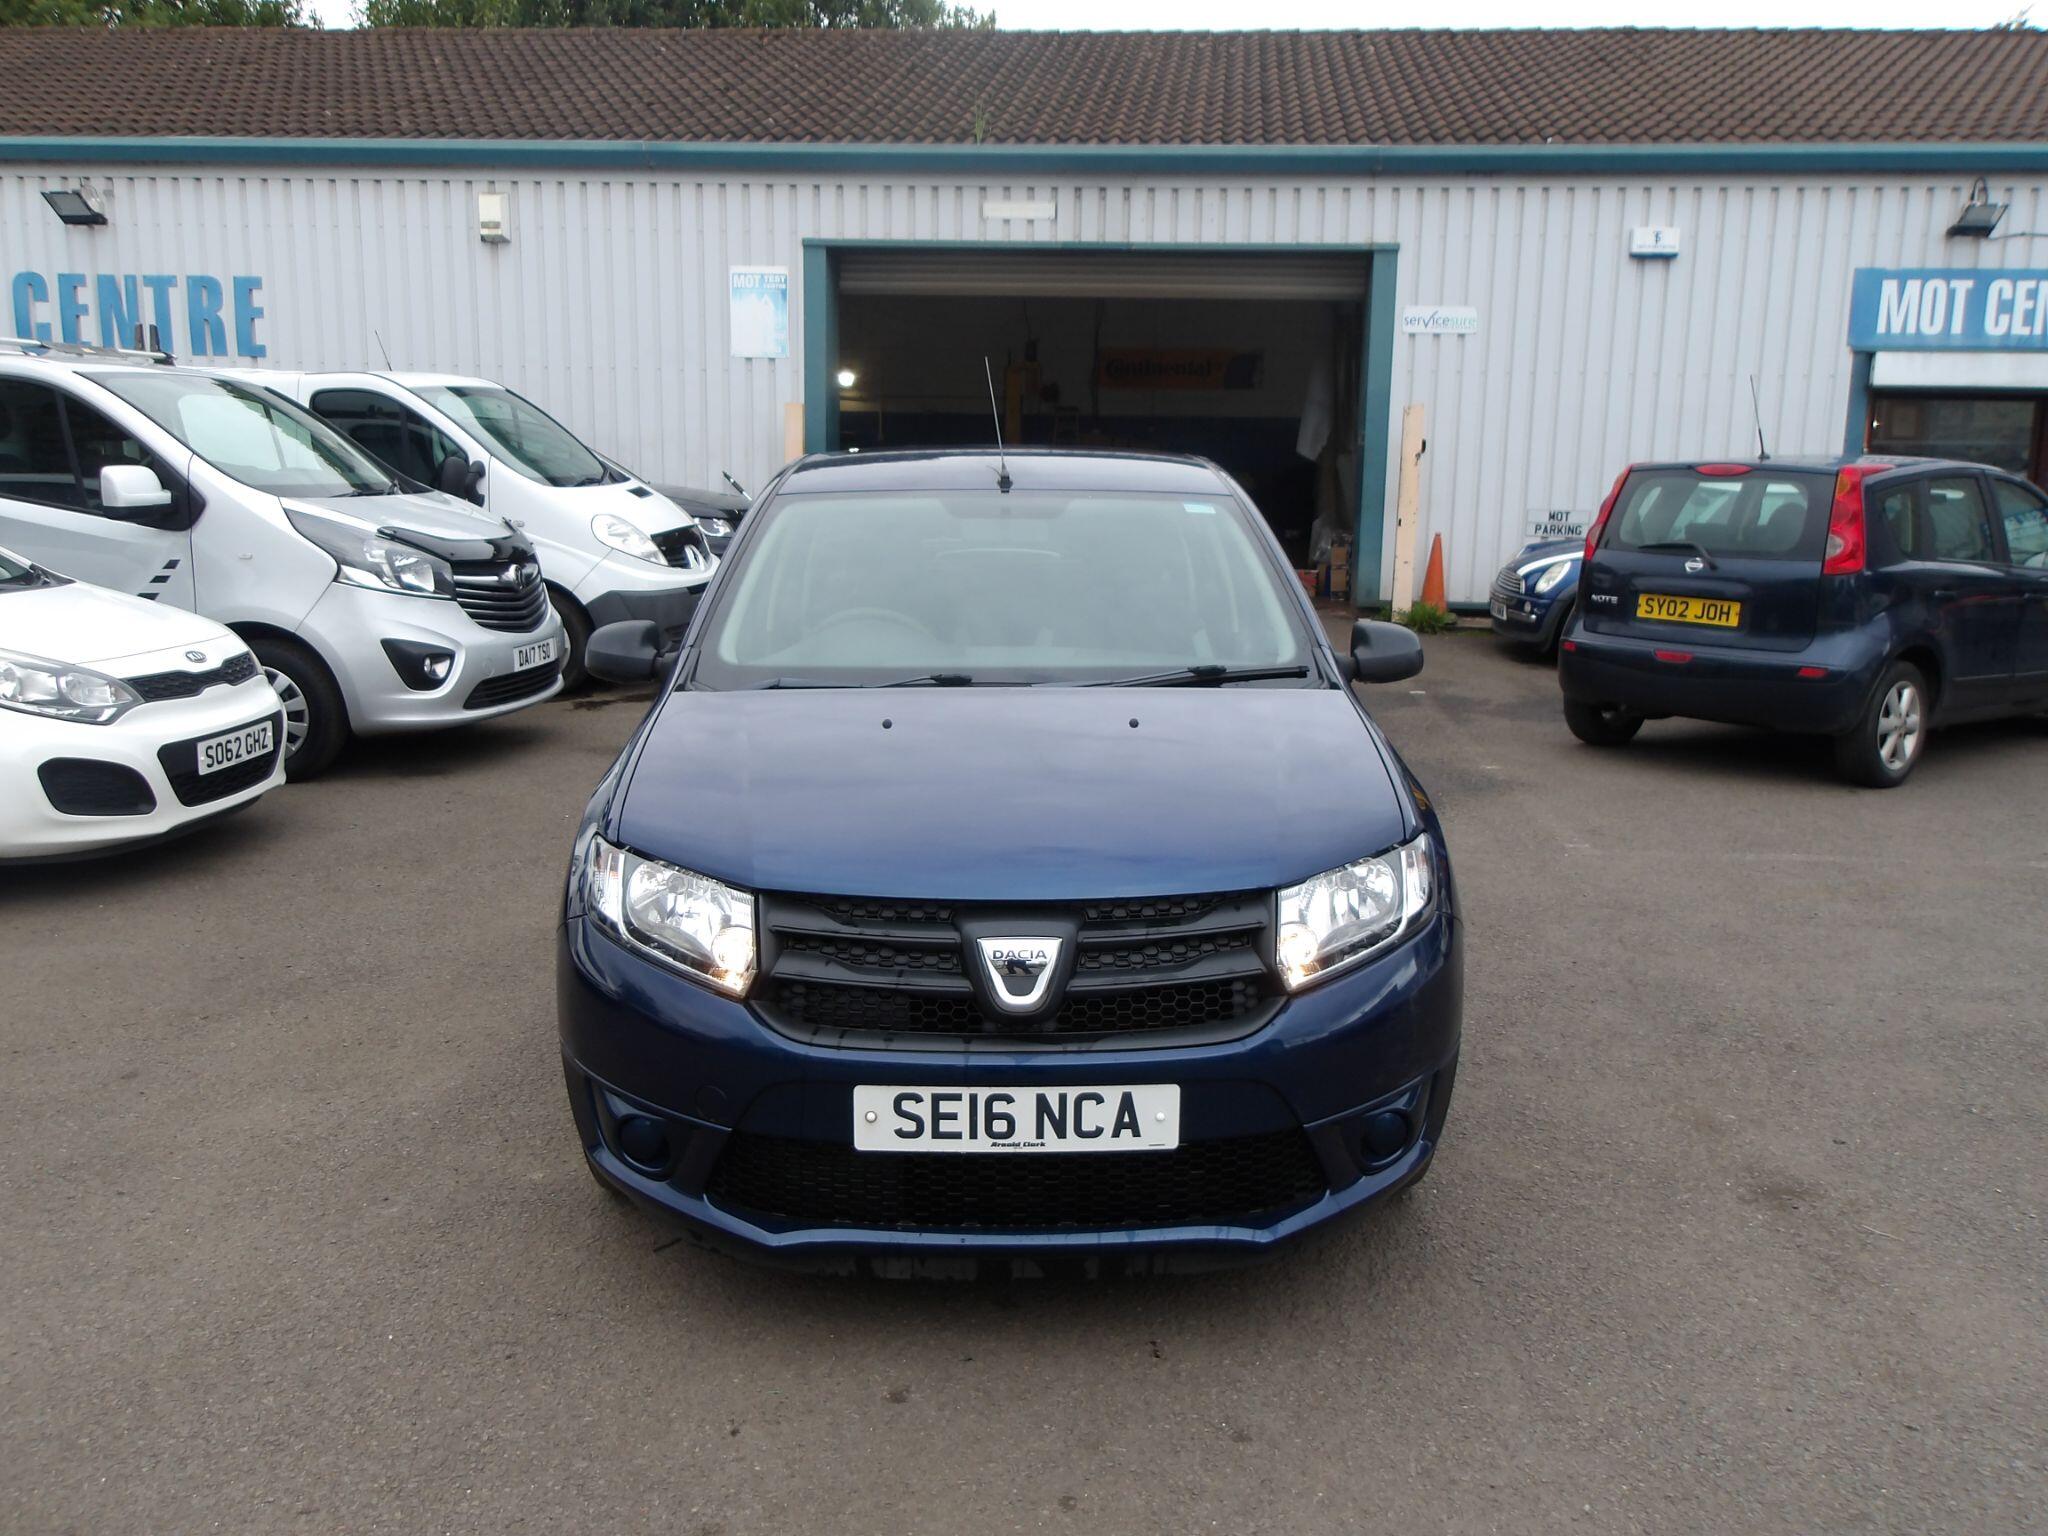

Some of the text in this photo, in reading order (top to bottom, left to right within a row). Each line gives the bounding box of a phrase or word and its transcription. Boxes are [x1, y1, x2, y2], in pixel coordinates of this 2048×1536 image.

[733, 274, 761, 289] MOT
[12, 271, 267, 358] CENTRE
[1876, 278, 1975, 335] MOT
[1548, 511, 1571, 522] MOT
[1534, 525, 1582, 536] PARKING
[1644, 597, 1732, 623] SY02 JOH
[205, 727, 269, 768] SO62 GHZ
[992, 949, 1047, 960] DACIA
[892, 1091, 1142, 1140] SE16 NCA
